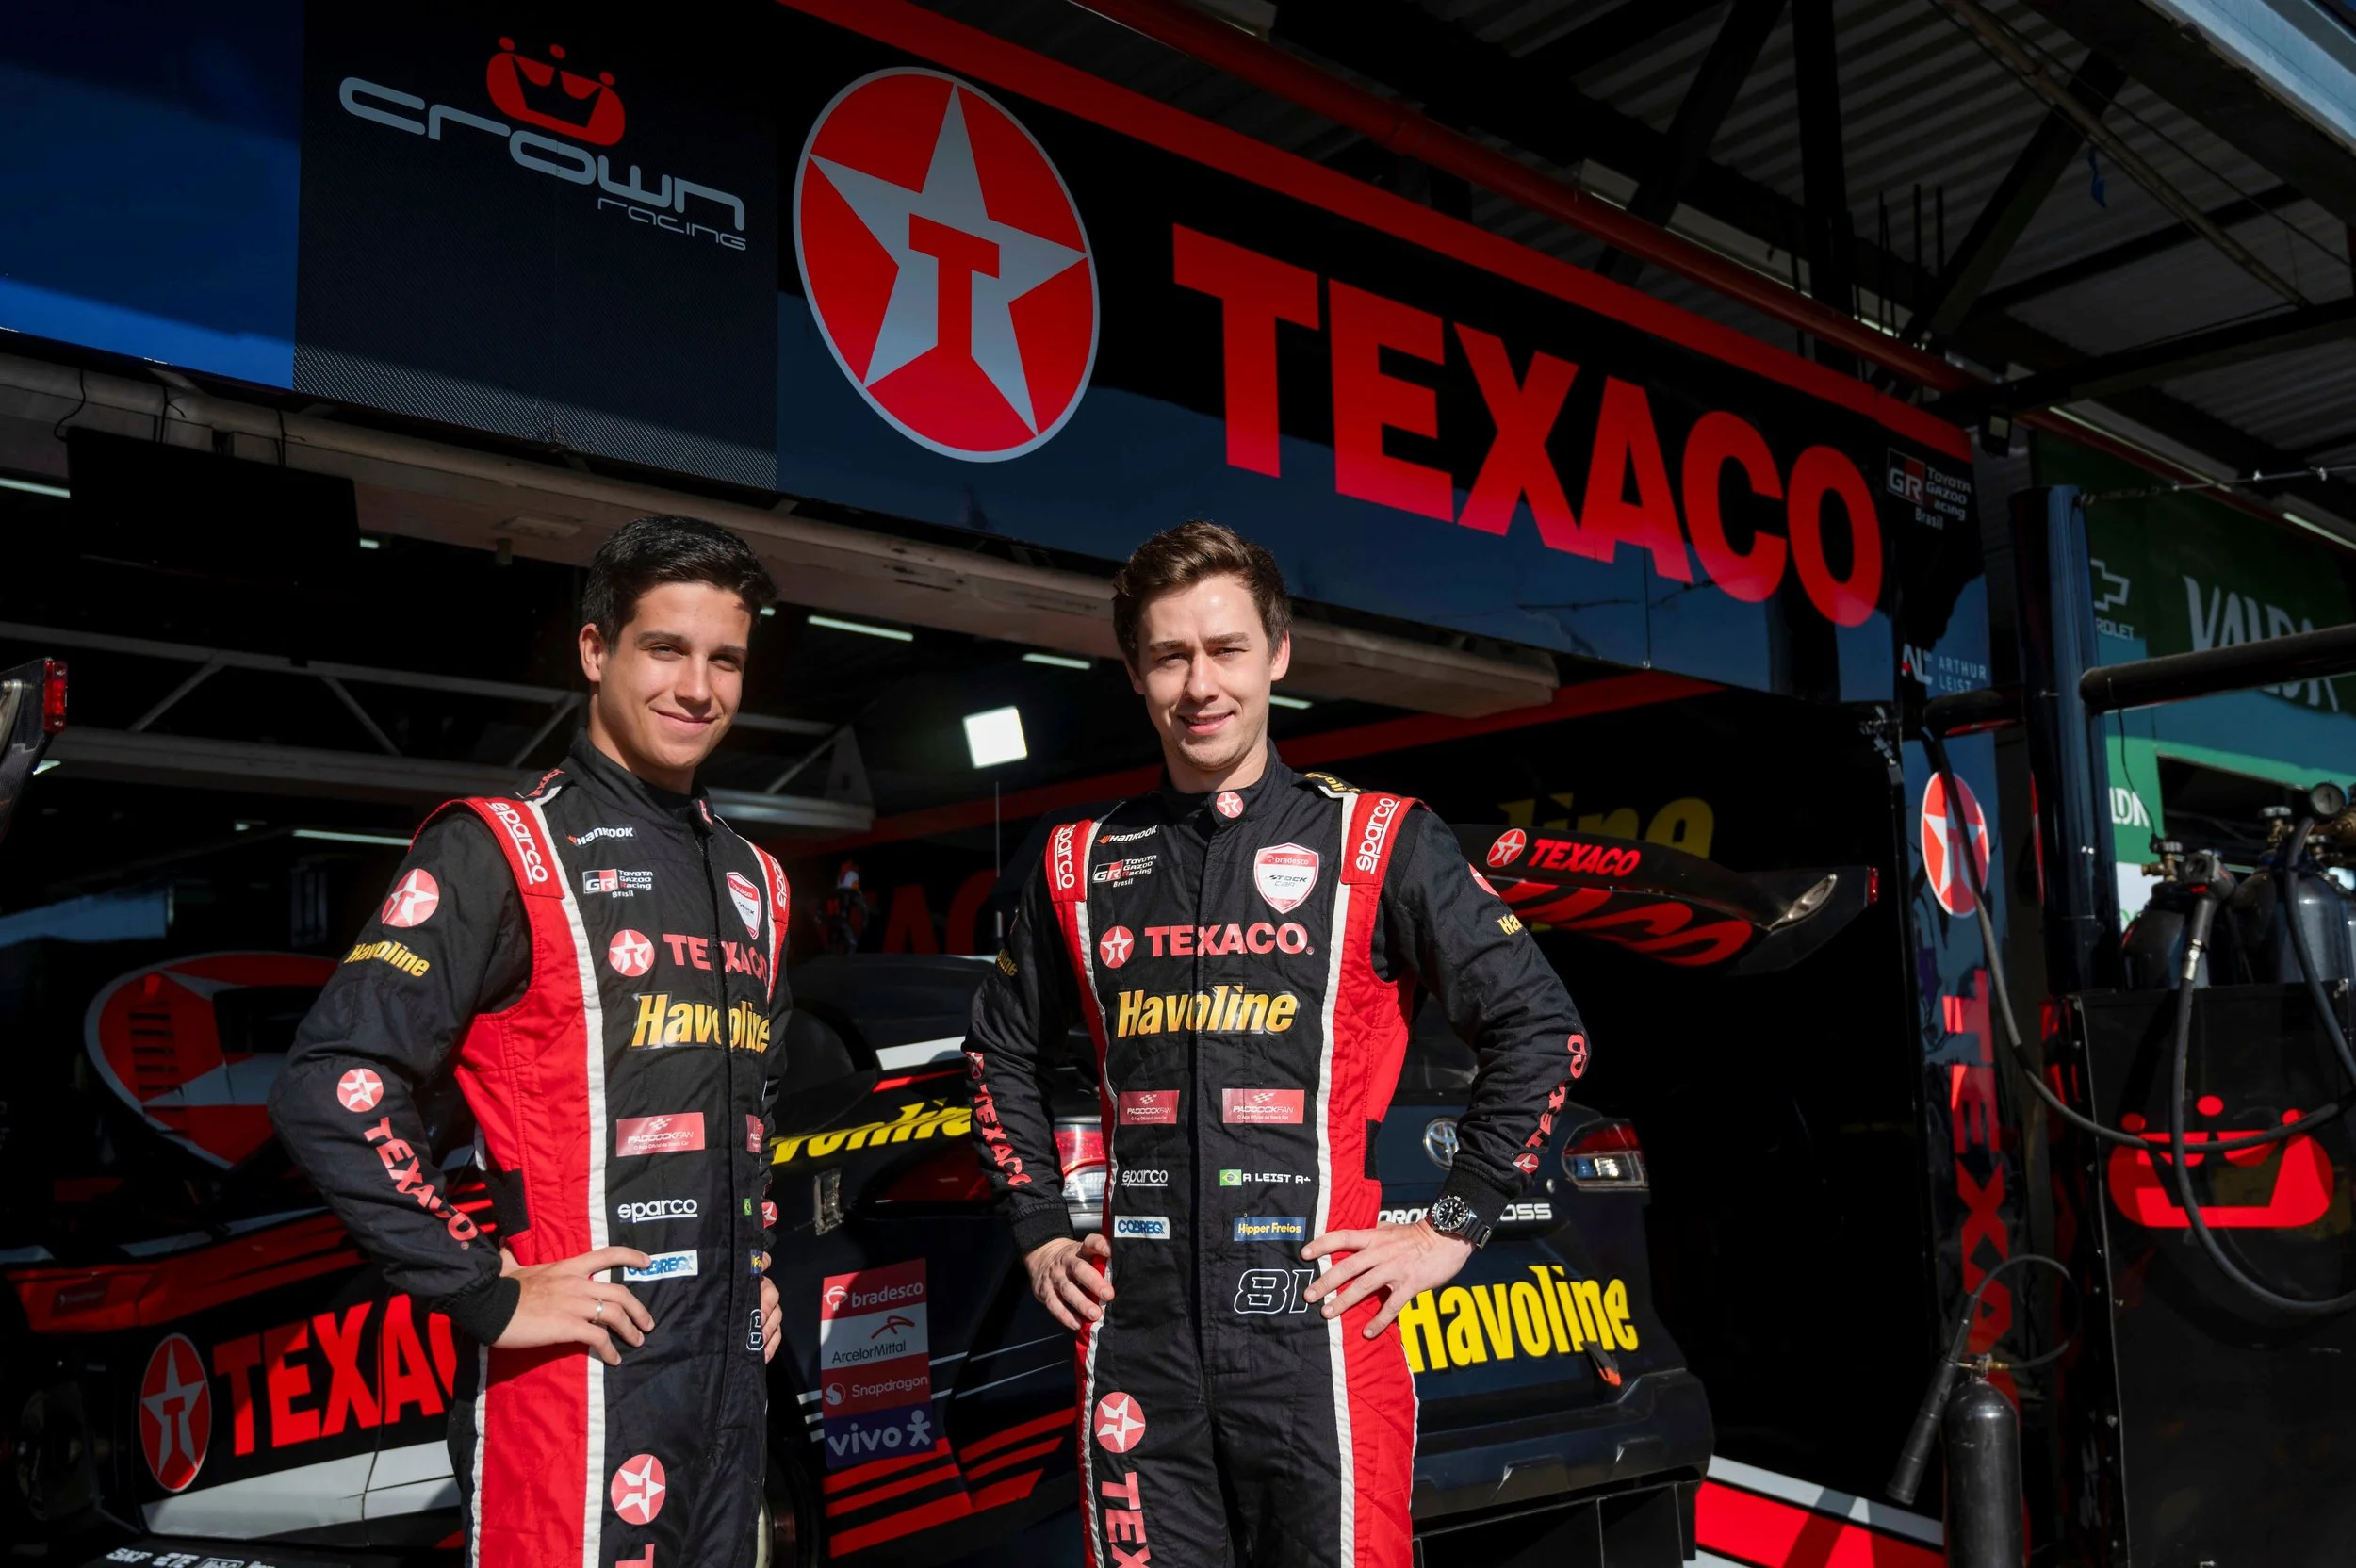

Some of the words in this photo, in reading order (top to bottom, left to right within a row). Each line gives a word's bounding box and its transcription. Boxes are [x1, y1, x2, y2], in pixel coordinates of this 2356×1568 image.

[339, 76, 744, 231] crown
[597, 198, 746, 252] racing
[1173, 222, 1883, 628] TEXACO
[1889, 466, 1923, 502] GR
[1925, 466, 1972, 495] TOYOTA
[1914, 507, 1944, 531] Brasil
[1939, 656, 1988, 681] ARTHUR
[1939, 675, 1972, 694] LEIST
[485, 802, 548, 885] sparco
[1356, 797, 1401, 875] sparco
[1122, 862, 1153, 872] GAZOO
[1124, 855, 1157, 865] TOYOTA
[1274, 857, 1309, 865] bradesco
[1526, 837, 1643, 878] TEXACO
[1093, 869, 1121, 882] GR
[1113, 877, 1134, 889] Brasil
[1121, 868, 1152, 877] Racing
[585, 878, 617, 892] GR
[620, 882, 652, 890] Racing
[1144, 922, 1309, 957] TEXACO
[343, 940, 432, 977] Havoline
[663, 933, 768, 987] TEXACO
[1117, 985, 1299, 1037] Havoline
[631, 994, 771, 1054] Havoline
[1233, 1105, 1294, 1114] PADDOCKFAN
[627, 1131, 694, 1145] PADDOCKFAN
[1121, 1169, 1169, 1187] sparco
[1255, 1173, 1291, 1184] LEIST
[617, 1199, 698, 1223] sparco
[1118, 1219, 1163, 1235] COBREQ
[1237, 1223, 1269, 1236] Hipper
[1271, 1222, 1302, 1233] Freios
[851, 1282, 924, 1308] bradesco
[1399, 1266, 1639, 1373] Havoline
[831, 1340, 907, 1364] ArcelorMittal
[851, 1375, 928, 1397] Snapdragon
[827, 1422, 903, 1457] vivo
